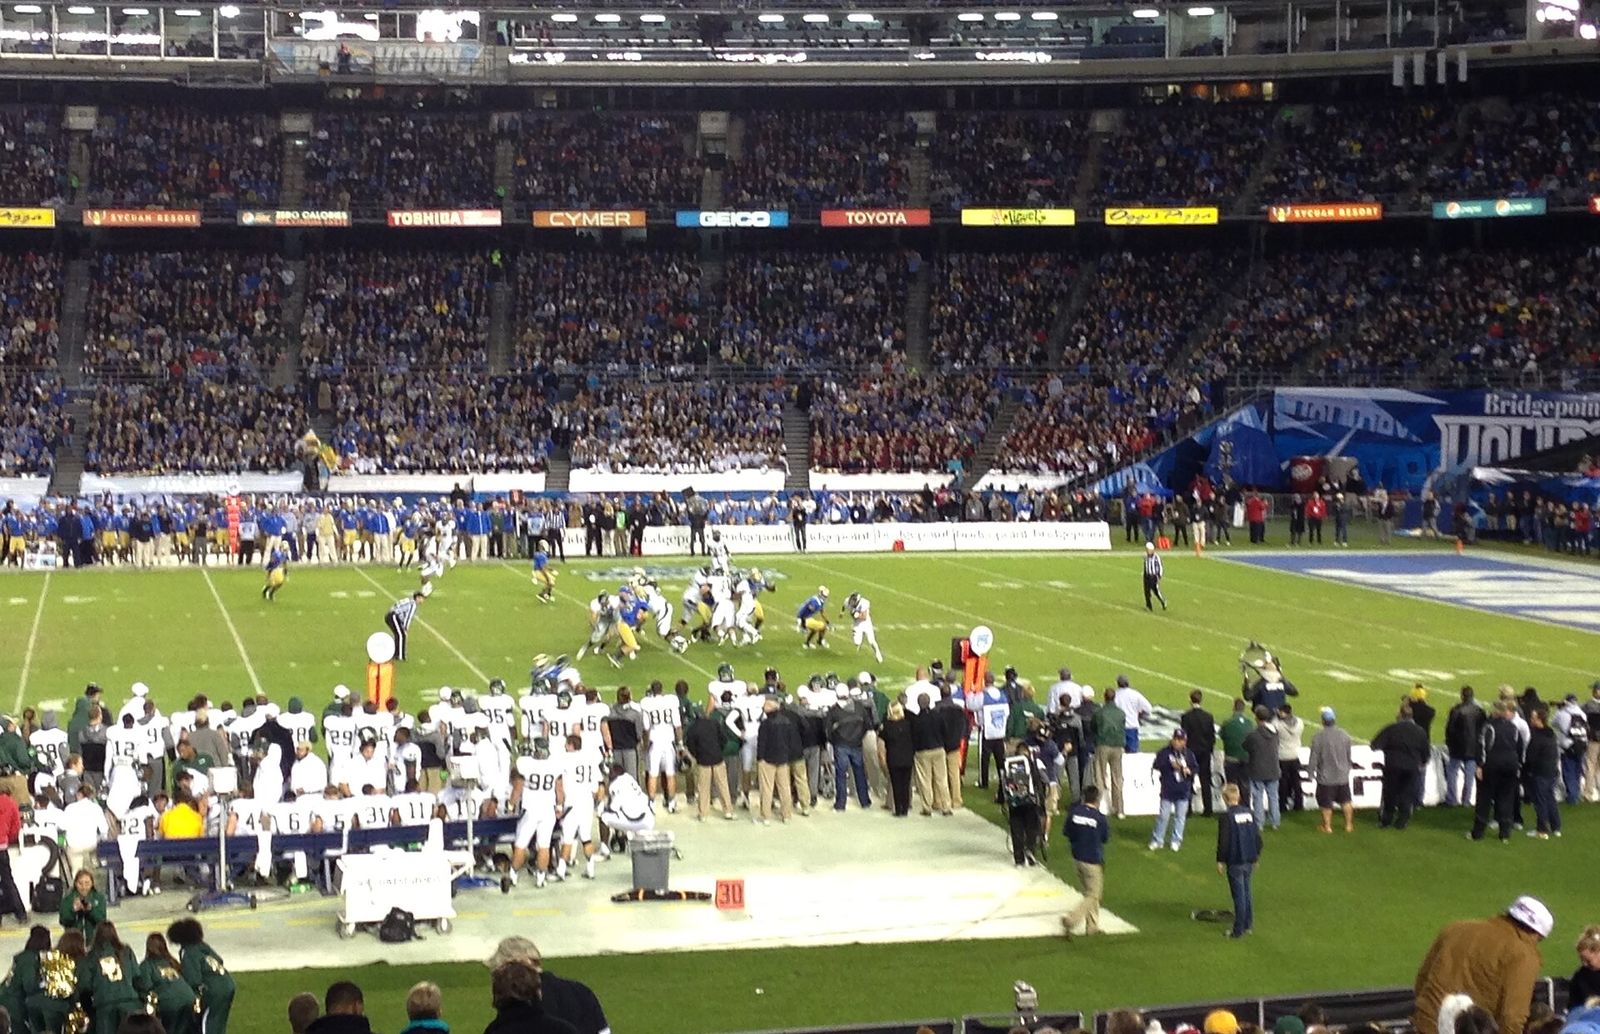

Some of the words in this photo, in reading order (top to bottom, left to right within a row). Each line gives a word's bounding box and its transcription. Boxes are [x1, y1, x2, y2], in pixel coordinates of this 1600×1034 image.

[157, 213, 197, 223] RESORT
[301, 210, 348, 221] CALORIES
[391, 212, 461, 226] TOSHIBA
[549, 212, 631, 227] CYMER
[699, 211, 771, 227] GEICO
[845, 211, 908, 225] TOYOTA
[1294, 208, 1335, 219] SYCUAN
[1338, 206, 1378, 217] RESORT
[649, 709, 672, 725] 88
[330, 730, 354, 746] 29
[114, 740, 136, 757] 12
[575, 765, 593, 783] 91
[528, 773, 555, 792] 98
[365, 806, 386, 824] 31
[408, 802, 425, 819] 11
[288, 813, 300, 831] 6
[718, 882, 743, 906] 30
